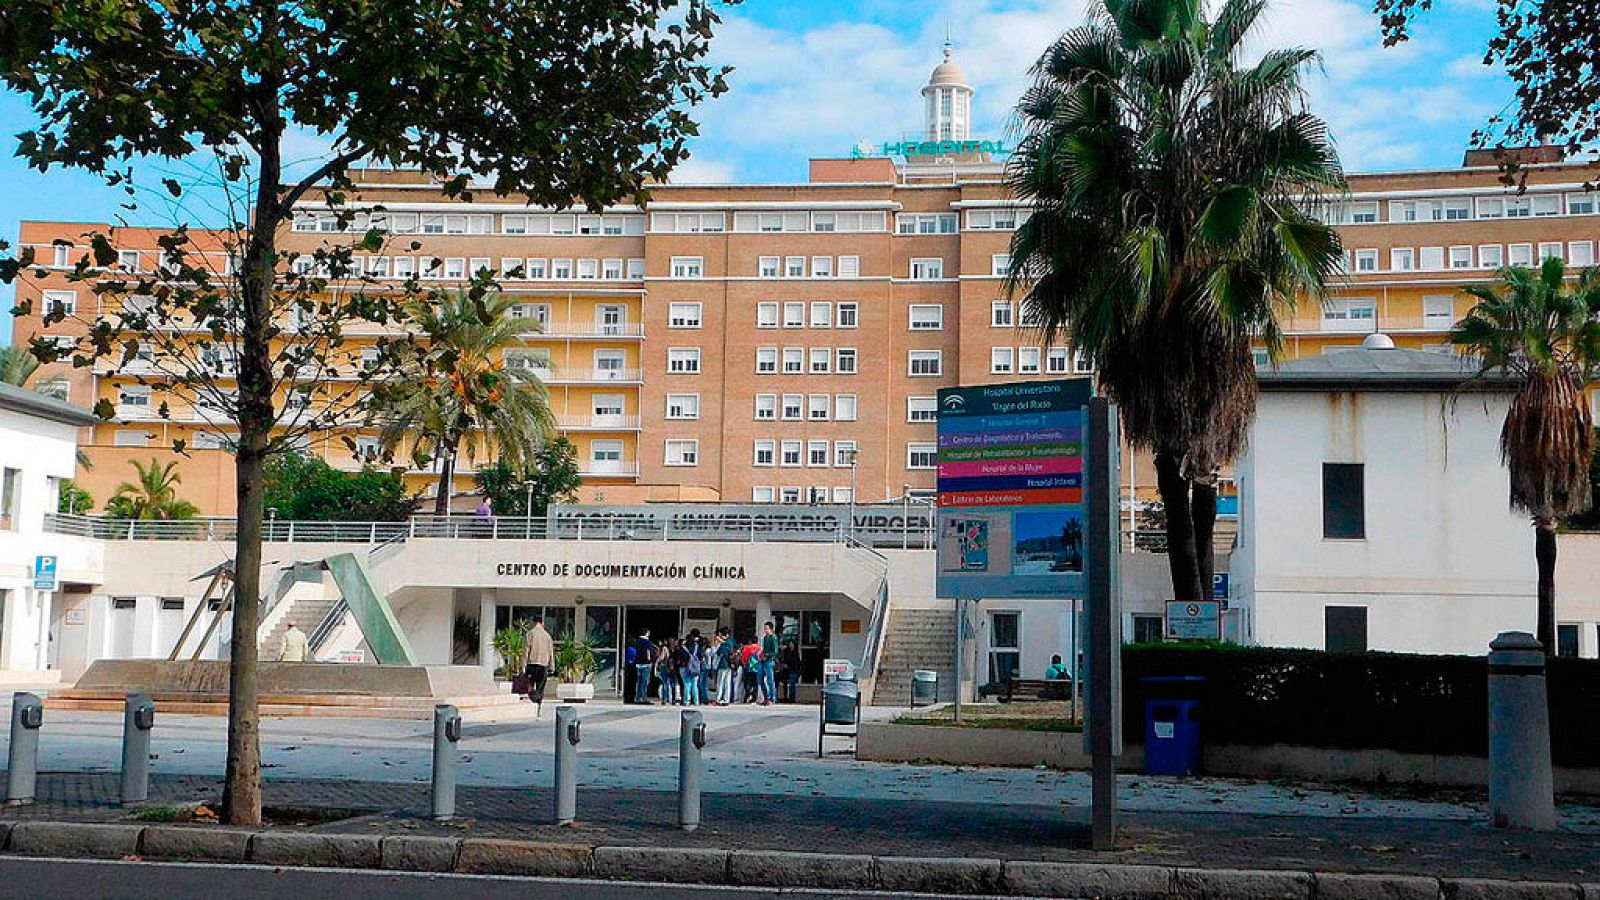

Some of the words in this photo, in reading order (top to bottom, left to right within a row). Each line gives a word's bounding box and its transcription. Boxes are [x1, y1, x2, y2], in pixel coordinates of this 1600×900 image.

[883, 140, 1012, 156] HOSPITAL
[1017, 400, 1029, 410] del
[557, 512, 662, 531] HOSPITAL
[673, 513, 837, 532] UNIVERSITARIO
[852, 515, 935, 534] VIRGEN
[41, 557, 52, 570] P
[497, 563, 547, 576] CENTRO
[553, 563, 570, 576] DE
[575, 562, 687, 579] DOCUMENTACIÓN
[693, 563, 746, 580] CLÍNICA
